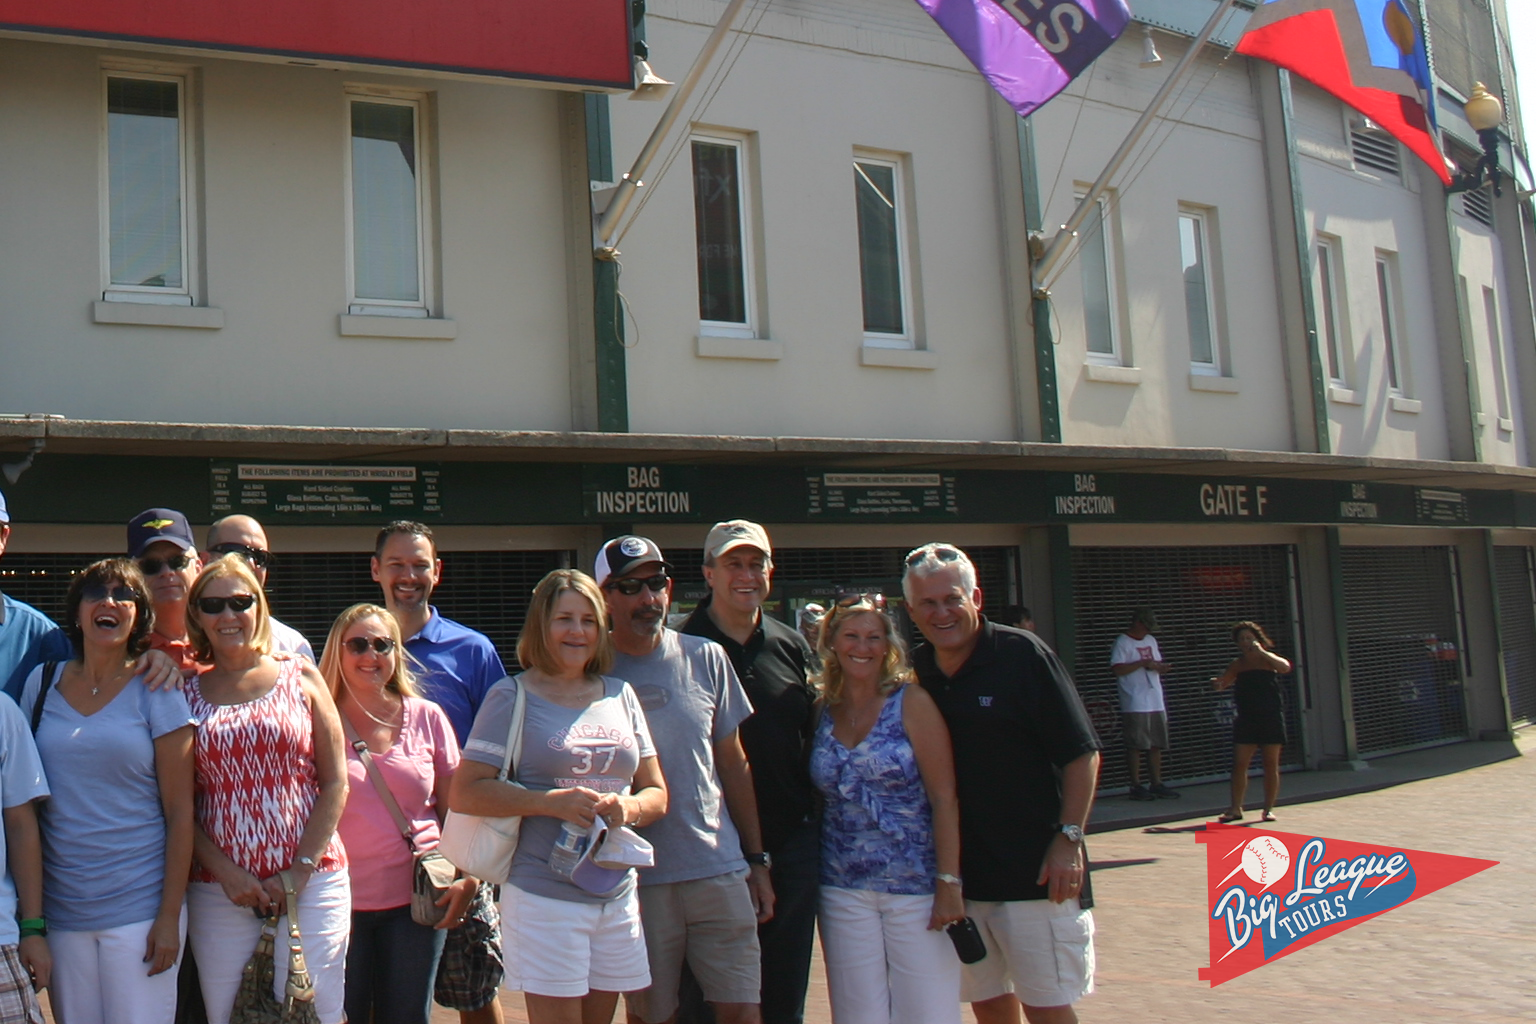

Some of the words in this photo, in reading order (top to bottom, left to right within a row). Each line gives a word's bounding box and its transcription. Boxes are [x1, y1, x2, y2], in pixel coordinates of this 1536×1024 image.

[627, 466, 660, 488] BAG
[1074, 474, 1096, 492] BAG
[597, 491, 690, 513] INSPECTION
[1055, 496, 1115, 515] INSPECTION
[1200, 483, 1249, 516] GATE
[1257, 485, 1267, 516] F
[547, 723, 633, 752] CHICAGO
[571, 746, 616, 775] 37
